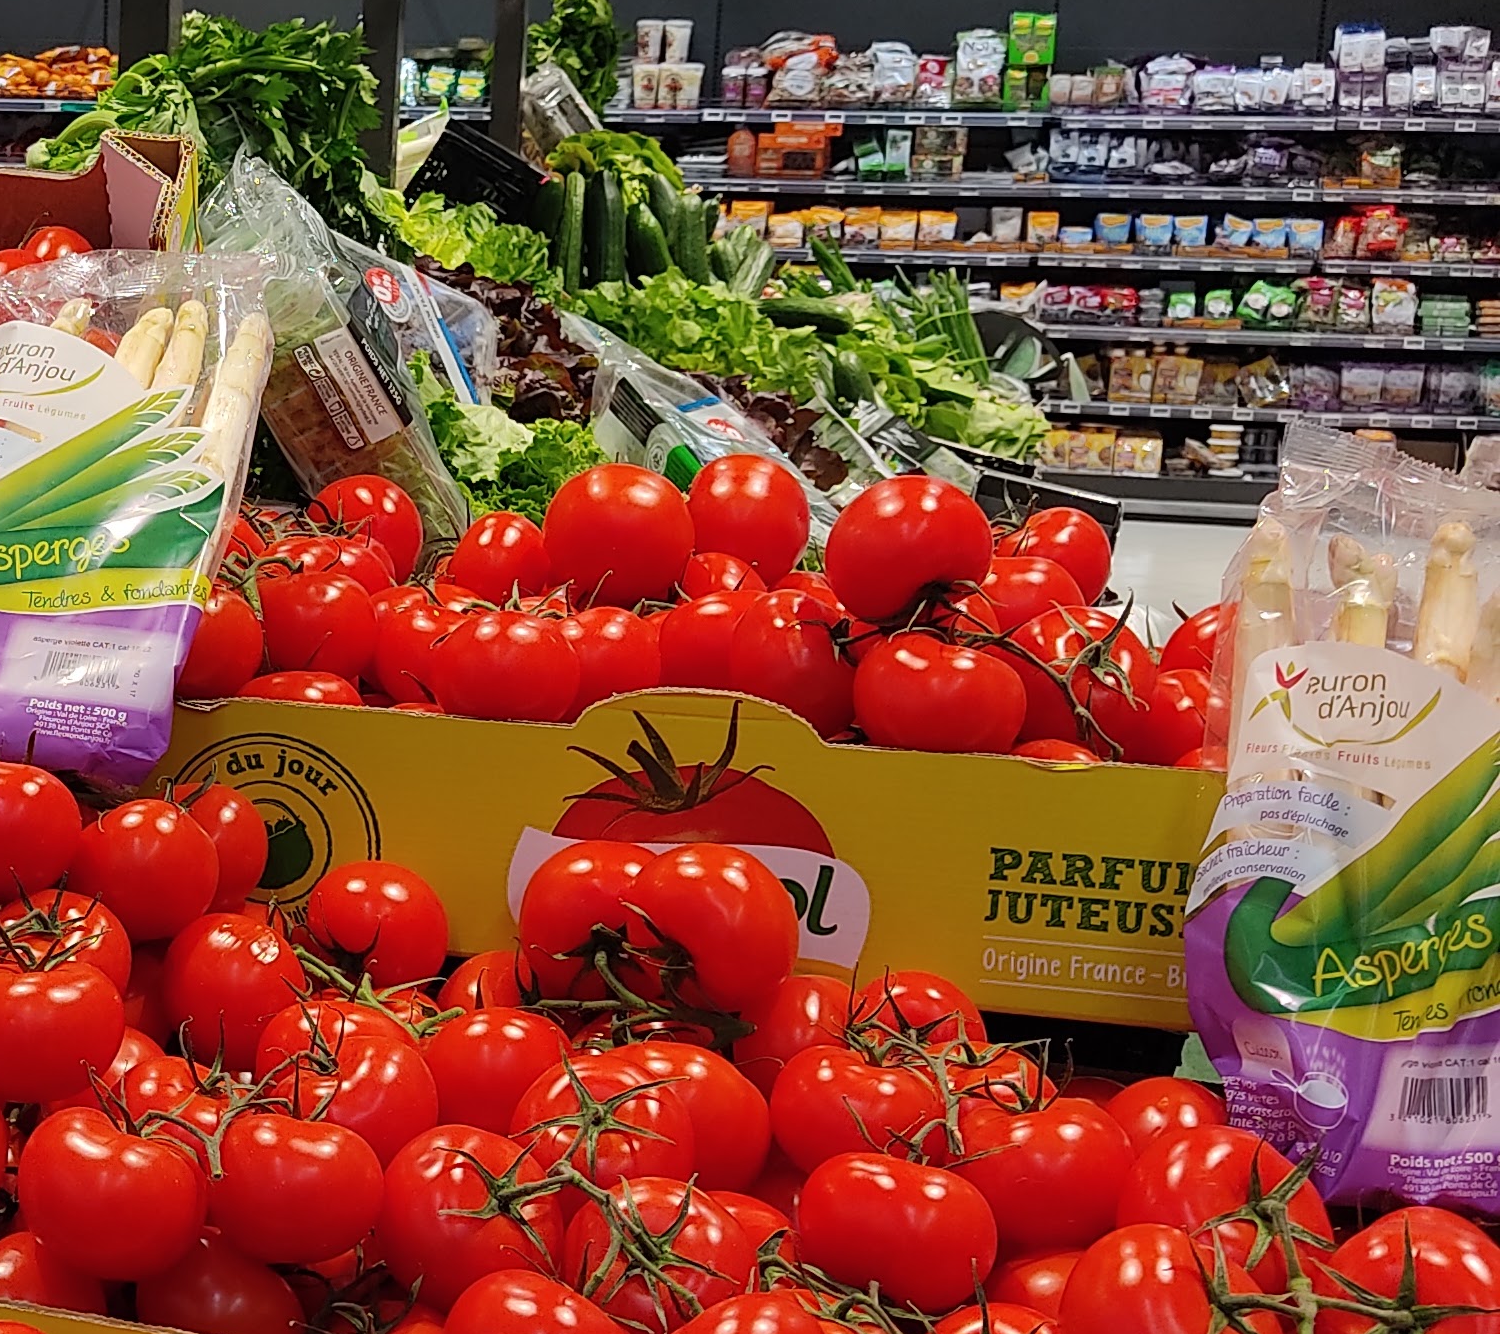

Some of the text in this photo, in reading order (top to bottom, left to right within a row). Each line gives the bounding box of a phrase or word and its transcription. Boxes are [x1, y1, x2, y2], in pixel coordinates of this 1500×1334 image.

[358, 337, 380, 367] POIDS
[375, 365, 389, 383] NET
[342, 349, 388, 417] ORIGINE FRANCE
[3, 398, 35, 411] Fruits
[22, 580, 209, 610] Tendres & fondantes
[29, 698, 128, 721] Poids net 500 g
[1318, 695, 1410, 726] d'Anjou
[1246, 742, 1278, 755] Fleurs
[1337, 750, 1379, 766] Fruits
[226, 748, 339, 797] du jour
[1223, 786, 1340, 812] Préparation facile
[1260, 808, 1349, 839] pas d'épluchage
[1226, 841, 1290, 858] fraîcheur
[988, 846, 1192, 897] PARFU
[1234, 862, 1306, 882] conservation
[984, 888, 1186, 939] JUTEUS
[982, 946, 1062, 980] Origine
[1069, 955, 1146, 986] France
[1390, 1153, 1431, 1168] Poids
[1465, 1151, 1494, 1164] 500
